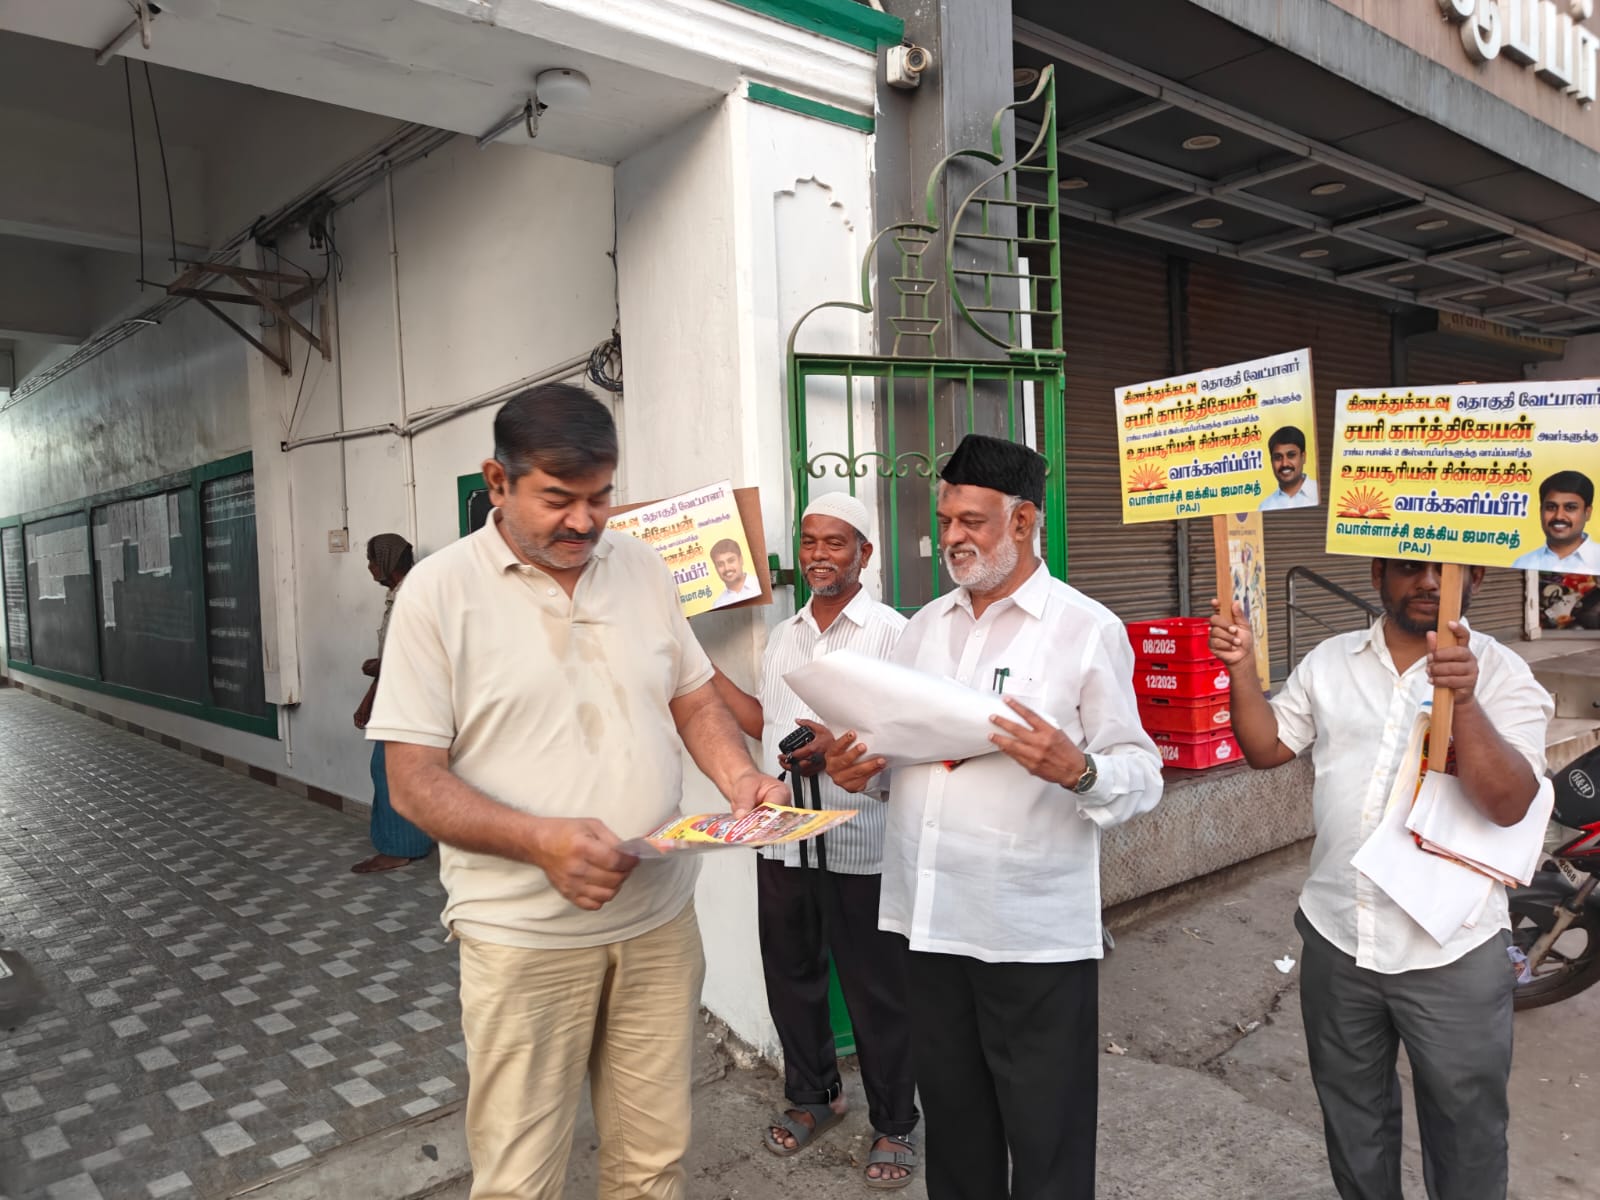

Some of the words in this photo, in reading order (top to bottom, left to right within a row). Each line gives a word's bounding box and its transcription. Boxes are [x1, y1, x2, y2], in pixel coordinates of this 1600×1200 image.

[1124, 382, 1198, 404] கிணத்துக்கடவு
[1201, 371, 1241, 391] தொகுதி
[1243, 357, 1300, 381] வேட்பாளர்
[1124, 407, 1153, 430] சபரி
[1157, 388, 1258, 424] கார்த்திகேயன்
[1261, 393, 1302, 407] அவர்களுக்கு
[1347, 393, 1449, 415] கிணத்துக்கடவு
[1457, 391, 1515, 410] தொகுதி
[1126, 435, 1196, 461] உதயசூரியன்
[1199, 425, 1262, 449] சின்னத்தில்
[1344, 418, 1385, 441] சபரி
[1388, 415, 1534, 446] கார்த்திகேயன்
[1537, 430, 1598, 443] அவர்களுக்கு
[1169, 450, 1262, 480] வாக்களிப்பீர்!
[1341, 461, 1438, 483] உதயசூரியன்
[1440, 461, 1532, 484] சின்னத்தில்
[642, 503, 677, 522] தொகுதி
[678, 487, 724, 511] வேட்பாளர்
[1129, 489, 1183, 507] பொள்ளாச்சி
[1186, 486, 1218, 501] ஐக்கிய
[1221, 480, 1261, 497] ஜமாஅத்
[1395, 490, 1528, 517] வாக்களிப்பீர்!
[1176, 503, 1200, 515] (PAJ)
[1336, 521, 1409, 538] பொள்ளாச்சி
[1413, 524, 1458, 541] ஐக்கிய
[1462, 529, 1520, 549] ஜமாஅத்
[1398, 541, 1431, 555] (PAJ)
[1143, 639, 1176, 654] 08/2025
[1145, 674, 1177, 689] 12/2025
